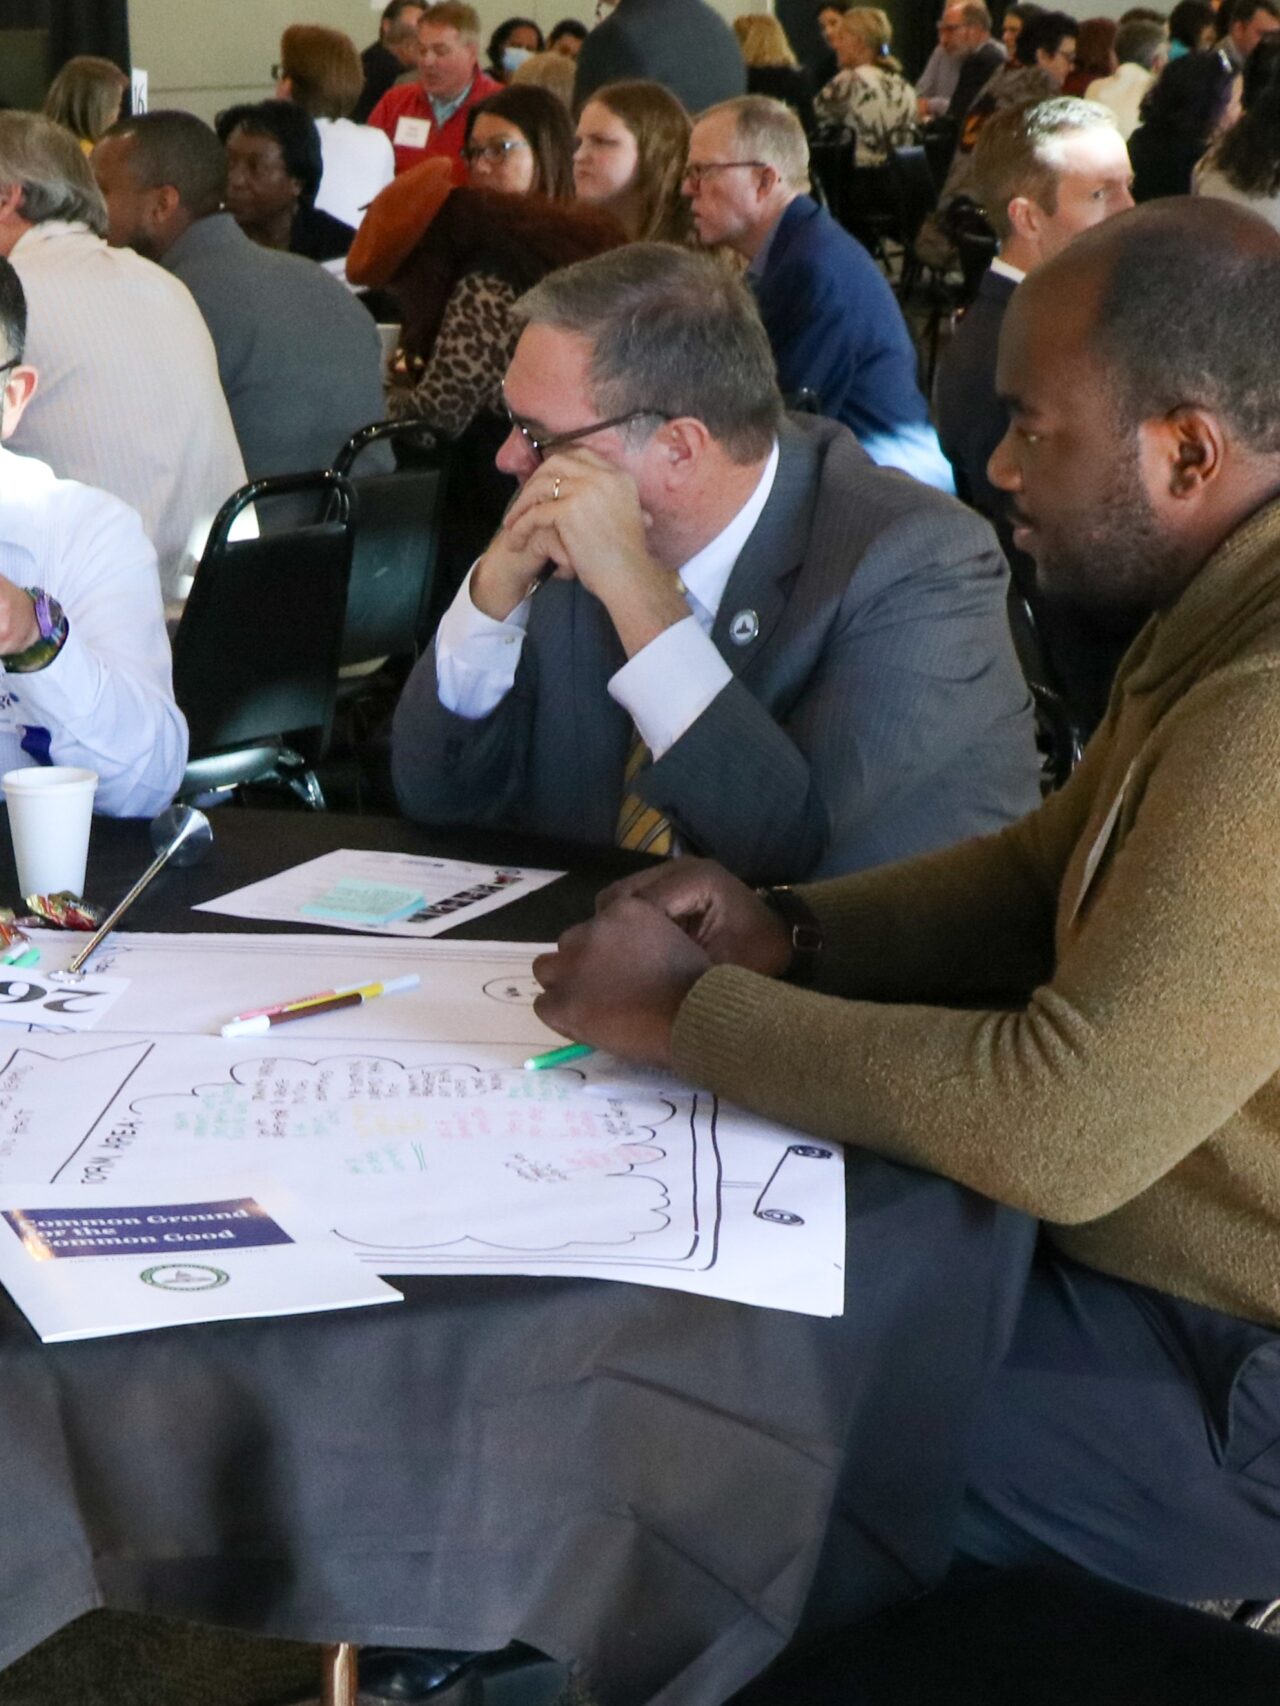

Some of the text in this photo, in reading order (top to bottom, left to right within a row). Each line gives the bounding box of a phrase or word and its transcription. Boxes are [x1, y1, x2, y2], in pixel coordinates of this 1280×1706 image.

[133, 84, 147, 116] 16
[147, 1209, 249, 1225] Ground
[72, 1226, 118, 1238] the
[163, 1229, 236, 1243] Good
